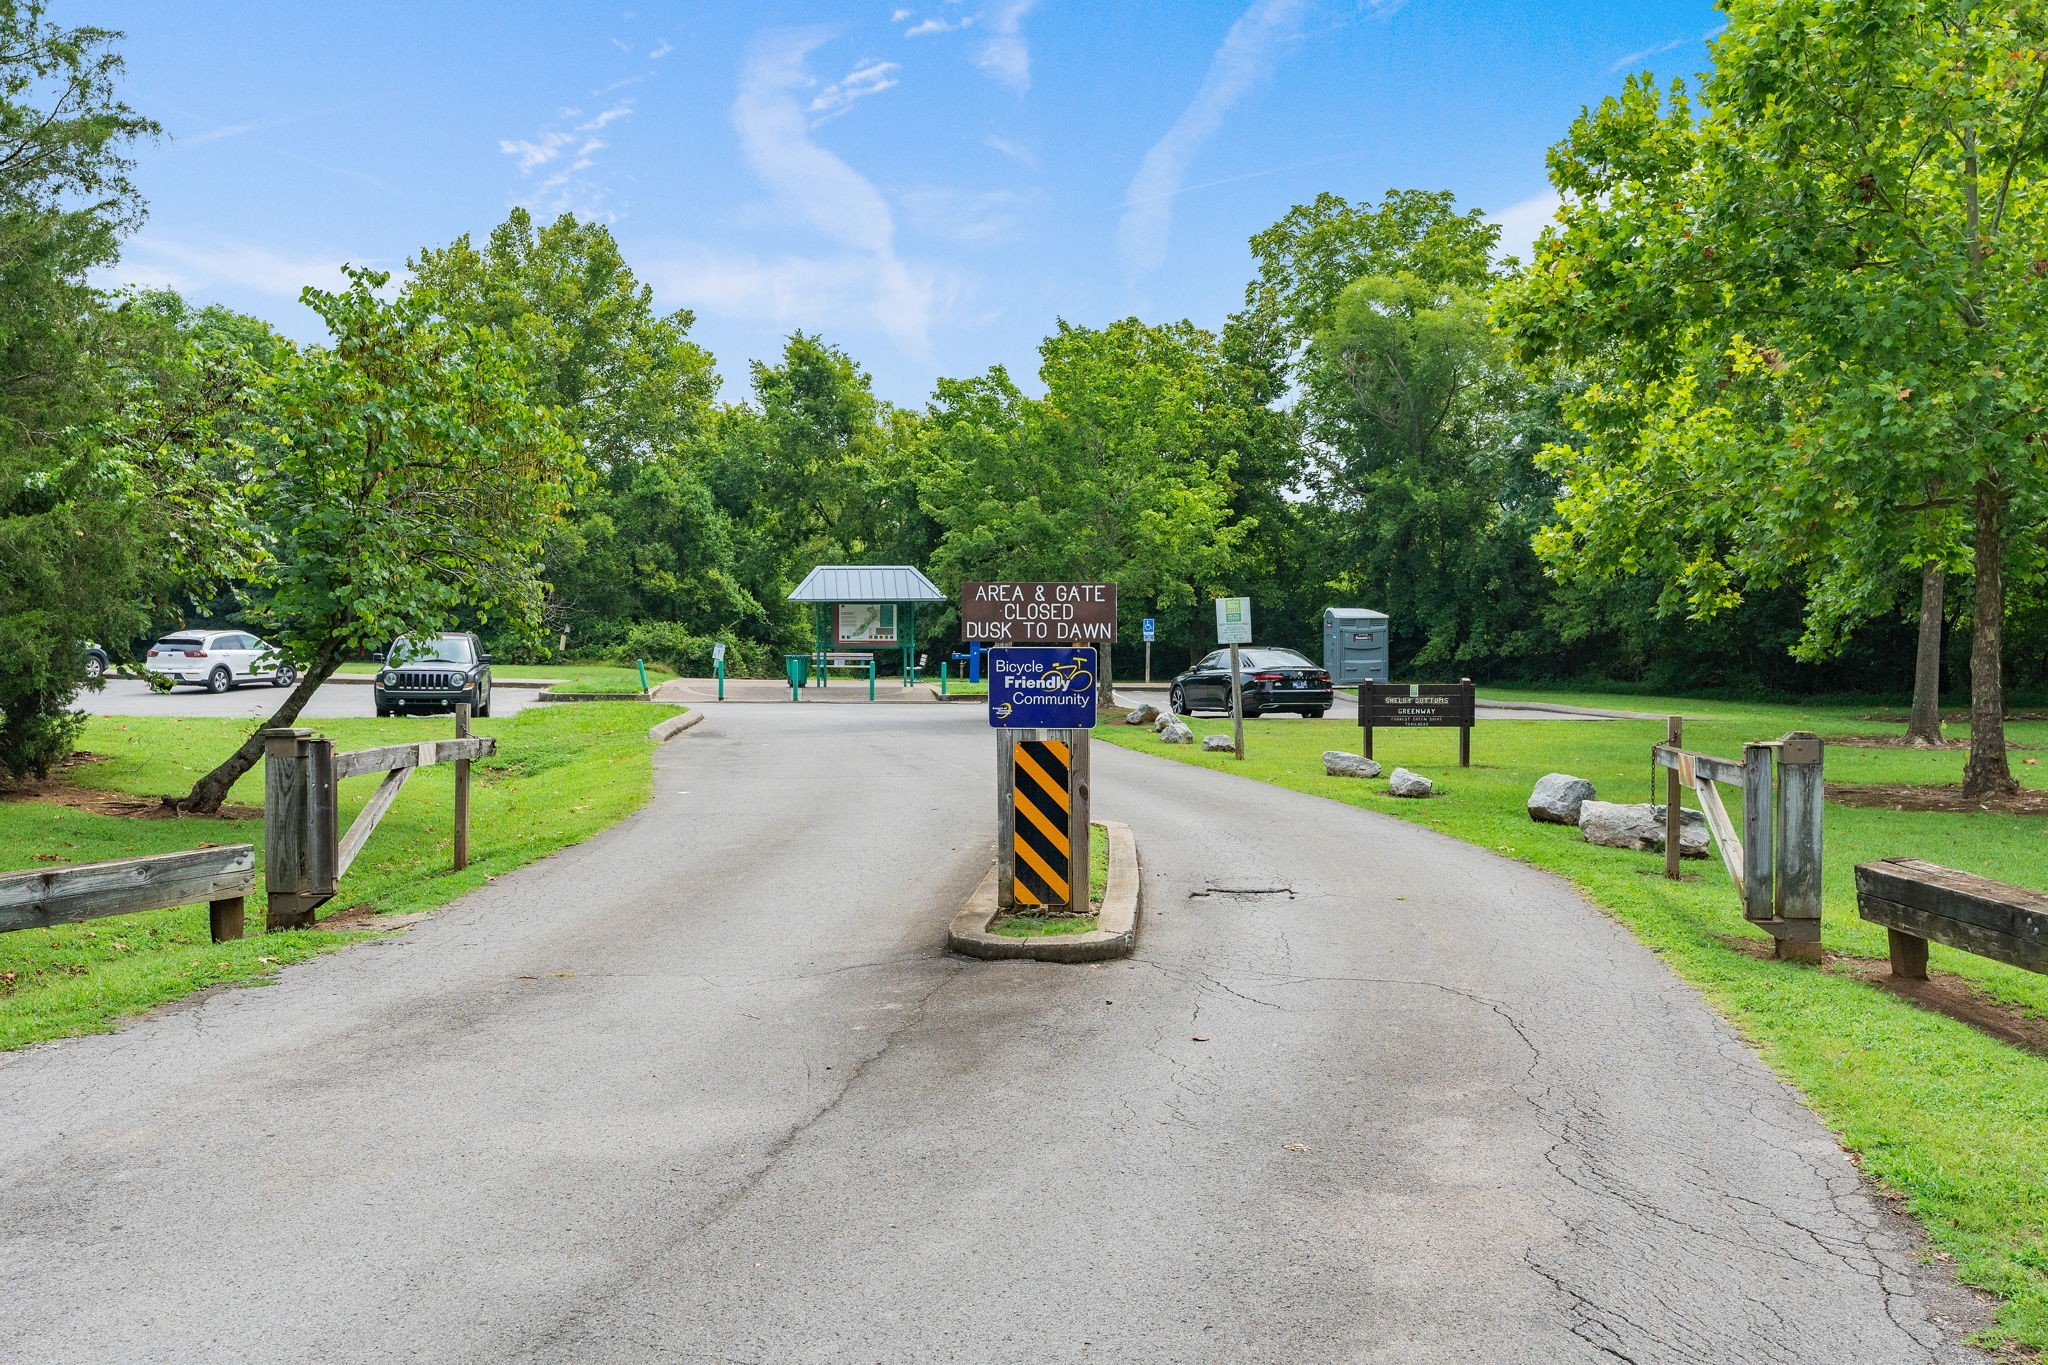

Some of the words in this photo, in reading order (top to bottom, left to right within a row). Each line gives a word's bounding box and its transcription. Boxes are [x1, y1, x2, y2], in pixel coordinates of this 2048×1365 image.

[975, 585, 1024, 602] AREA
[1034, 585, 1046, 602] &
[1056, 585, 1106, 602] GATE
[1004, 603, 1074, 620] CLOSED
[966, 621, 1012, 639] DUSK
[1023, 621, 1048, 639] TO
[1057, 622, 1112, 640] DAWN
[996, 660, 1044, 676] Bicycle
[1004, 676, 1071, 692] Friendly
[1012, 691, 1090, 708] Community
